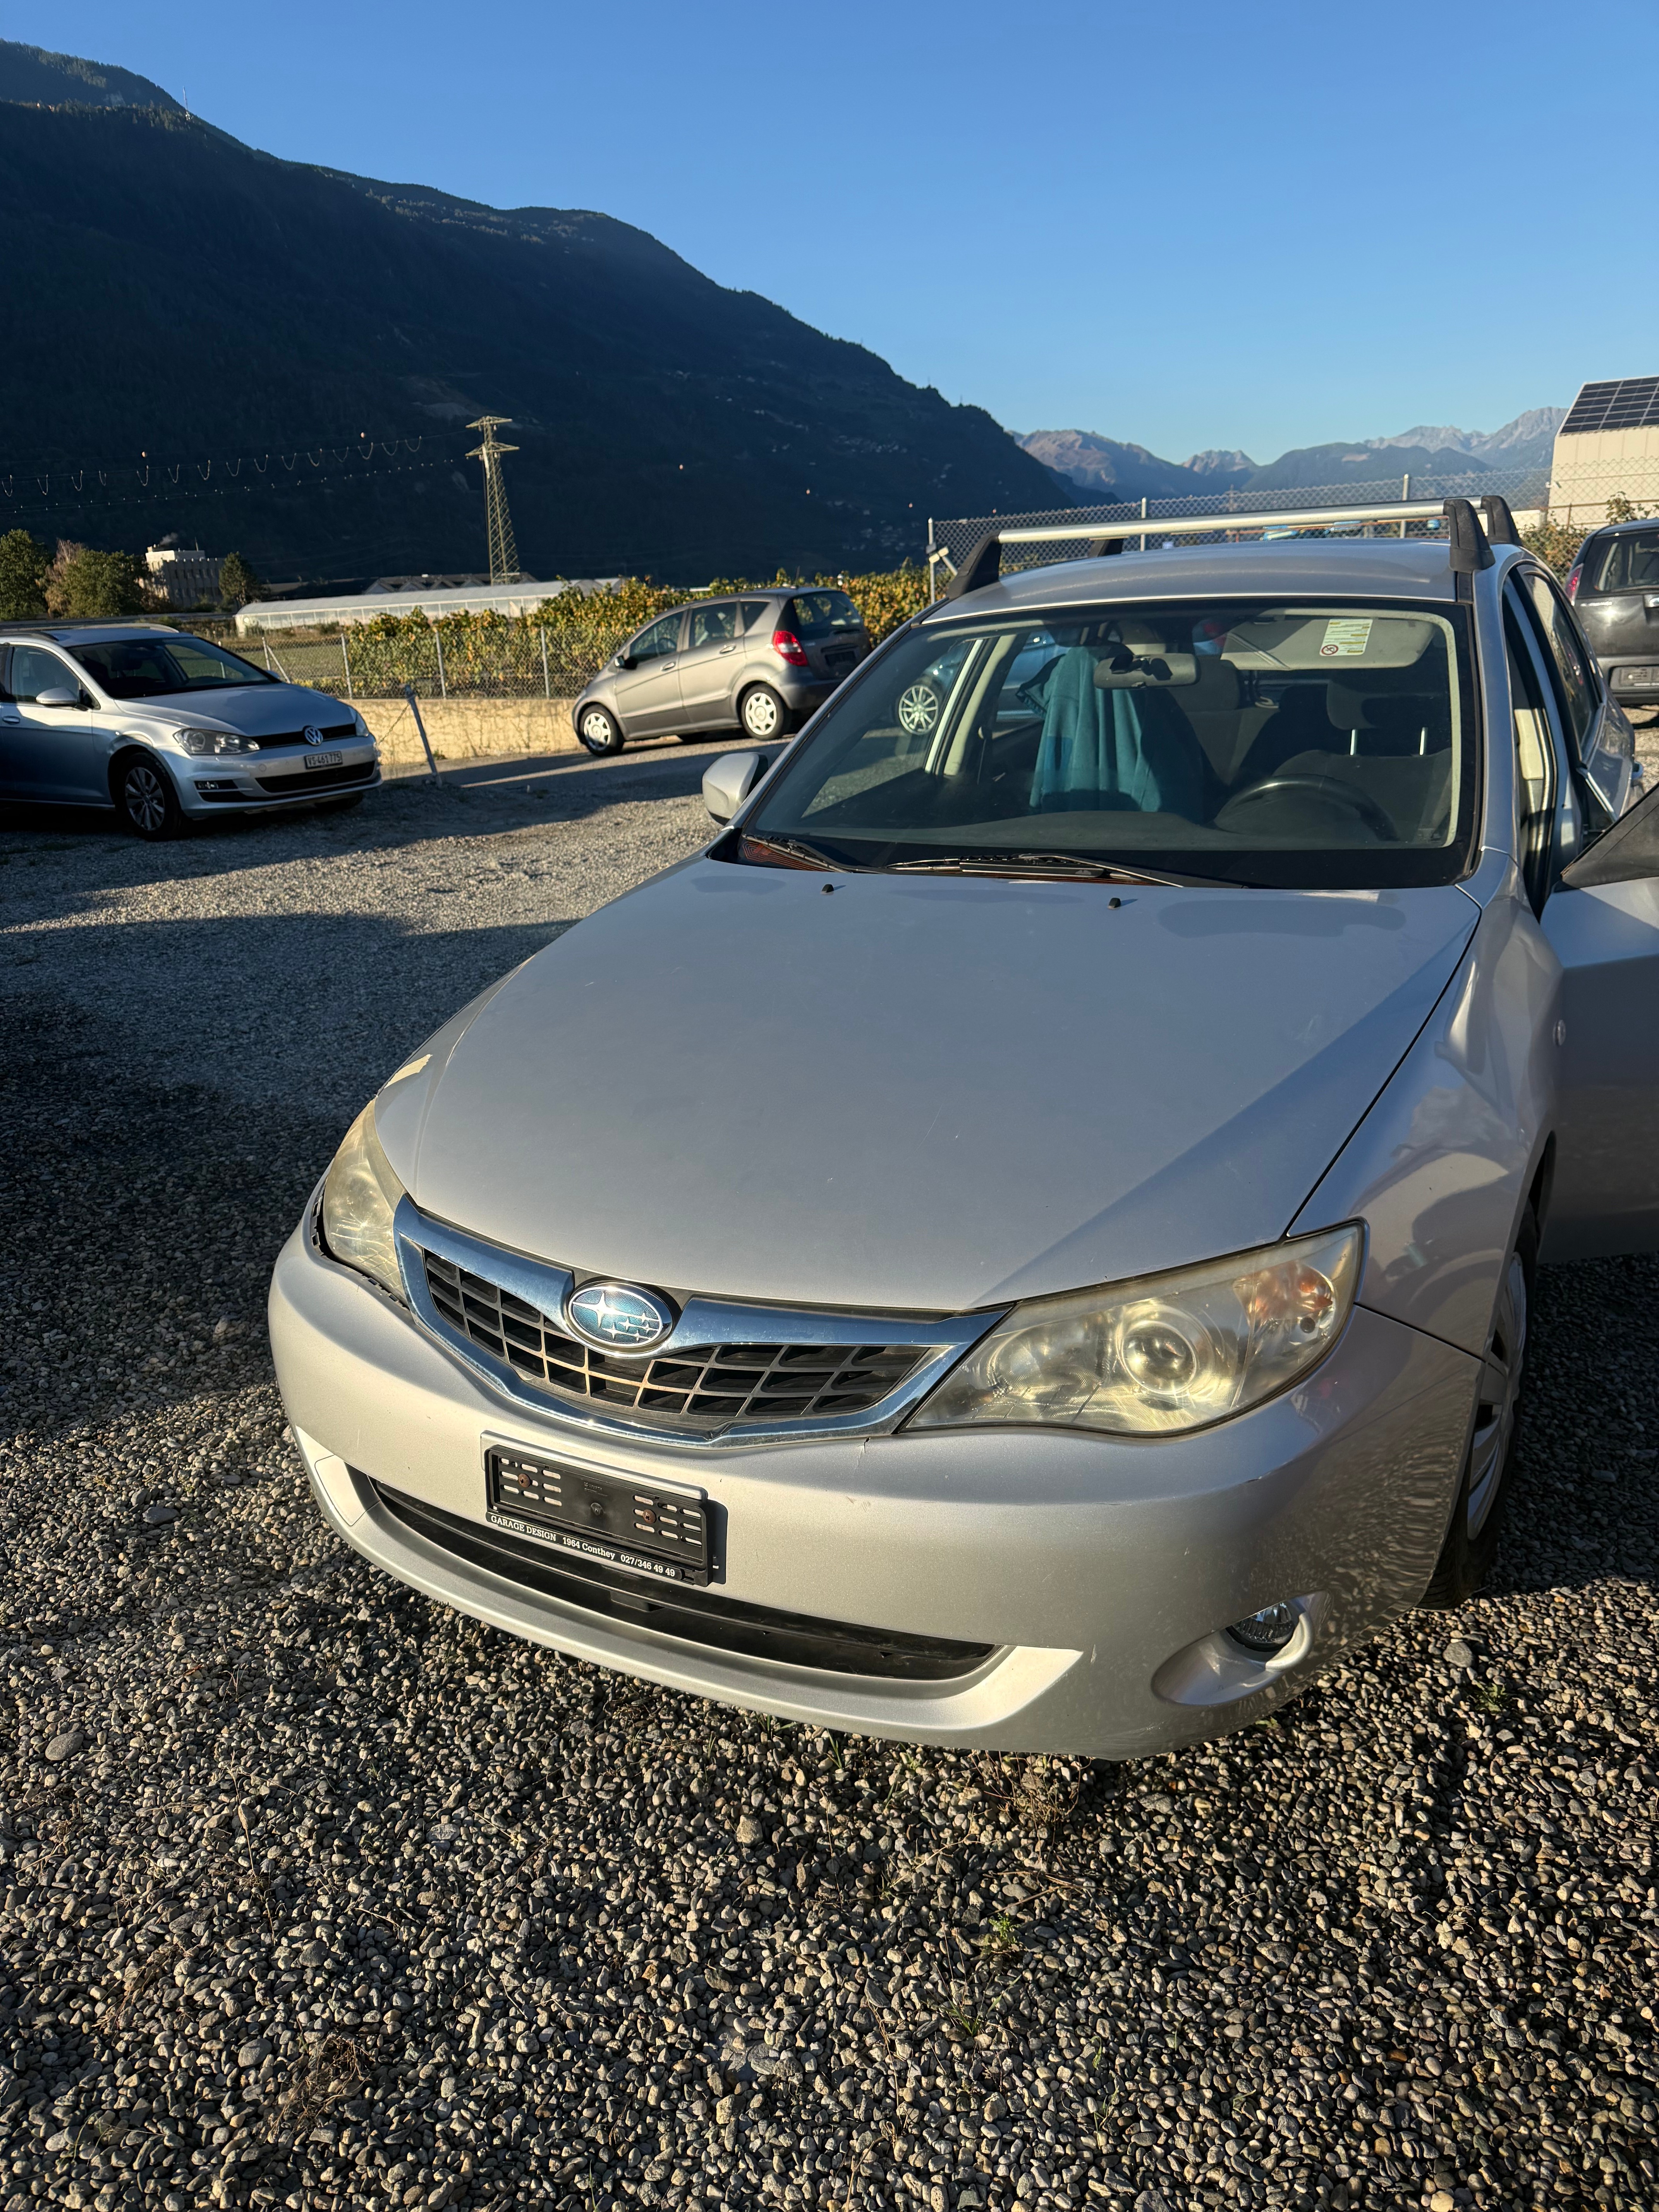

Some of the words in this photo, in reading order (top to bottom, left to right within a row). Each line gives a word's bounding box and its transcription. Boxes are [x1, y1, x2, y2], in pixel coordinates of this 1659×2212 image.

[491, 1515, 525, 1532] GARAGE
[526, 1525, 556, 1542] DESIGN
[562, 1537, 580, 1549] 1964
[582, 1542, 616, 1560] Conthey
[620, 1554, 652, 1570] 027/346
[653, 1564, 663, 1573] 49
[665, 1568, 675, 1577] 49
